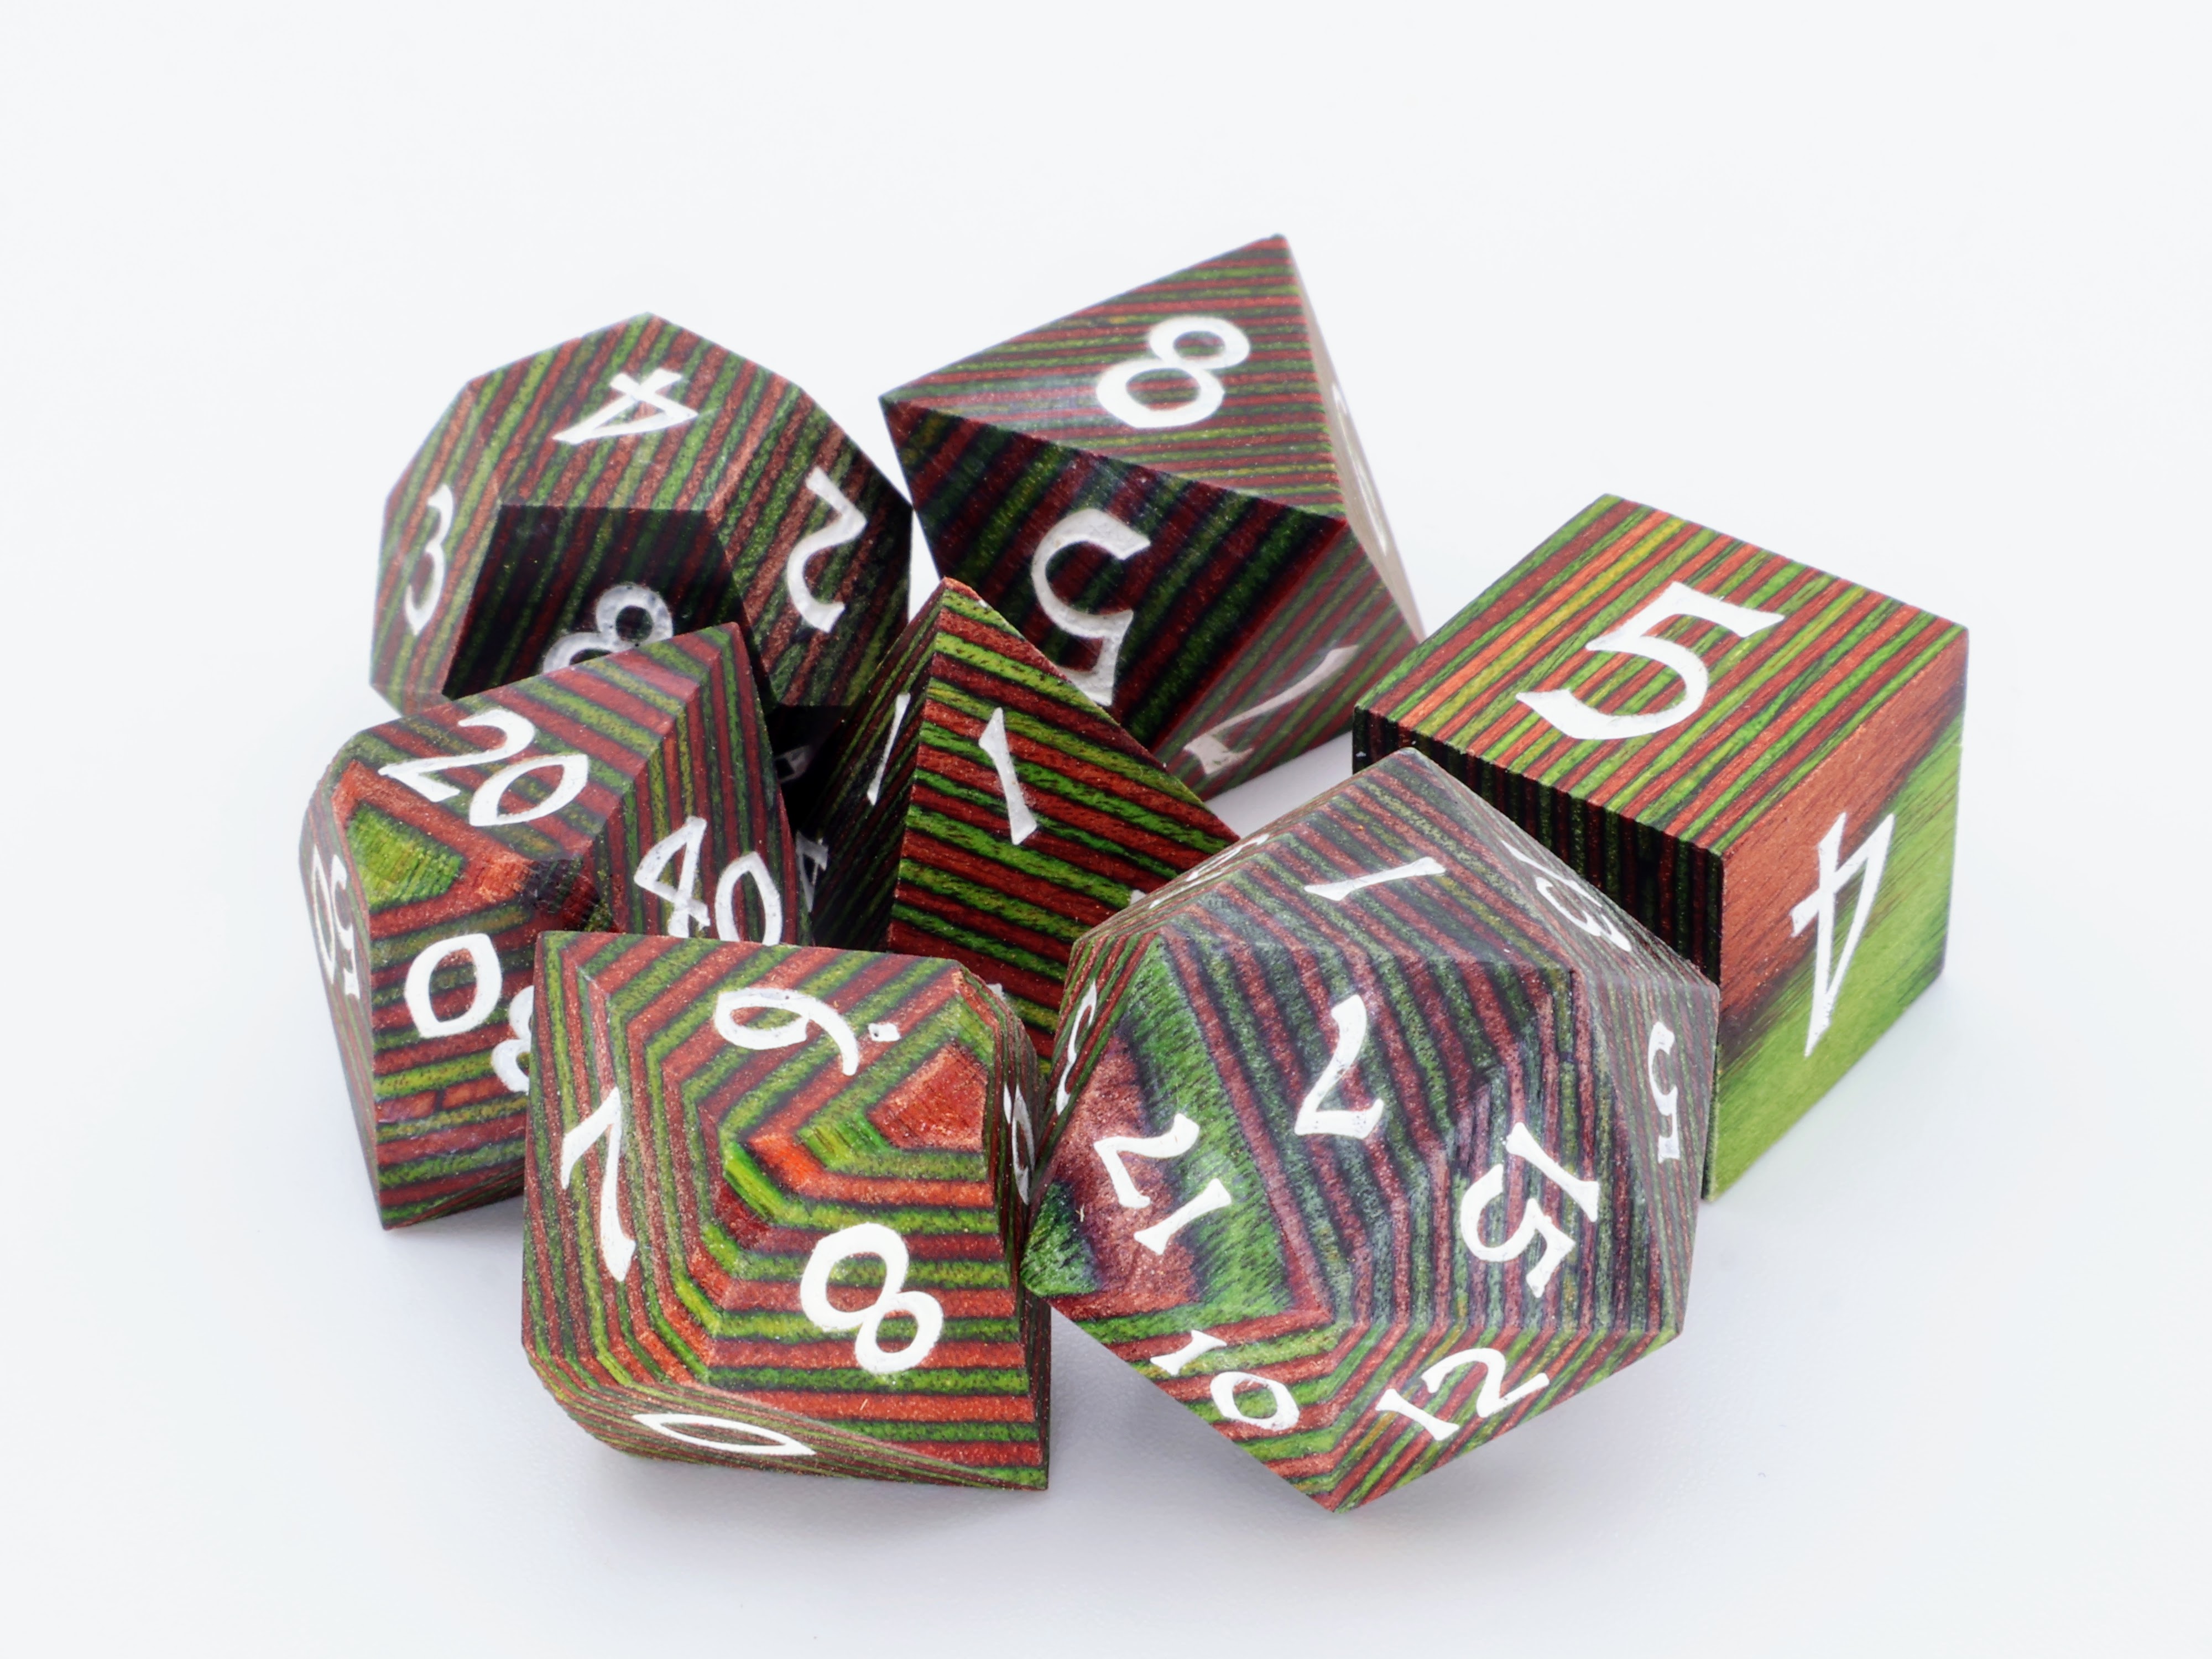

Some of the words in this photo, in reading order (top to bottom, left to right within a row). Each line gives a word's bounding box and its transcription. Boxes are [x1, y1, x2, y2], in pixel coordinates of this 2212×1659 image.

[553, 368, 698, 445] 4
[1095, 316, 1250, 429] 8
[404, 484, 453, 636] 3
[786, 466, 866, 632] 2
[1032, 509, 1150, 706] 5
[1516, 582, 1785, 740] 5
[378, 709, 589, 826] 20
[979, 708, 1037, 845] 1
[634, 817, 782, 947] 40
[1303, 857, 1446, 904] 1
[1500, 838, 1632, 952] 13
[1790, 812, 1895, 1057] 4
[1647, 1021, 1681, 1164] 5
[1460, 1121, 1600, 1298] 15
[800, 1222, 943, 1374] 8
[633, 1412, 816, 1455] 0
[1150, 1329, 1300, 1430] 10
[1376, 1348, 1550, 1441] 12
